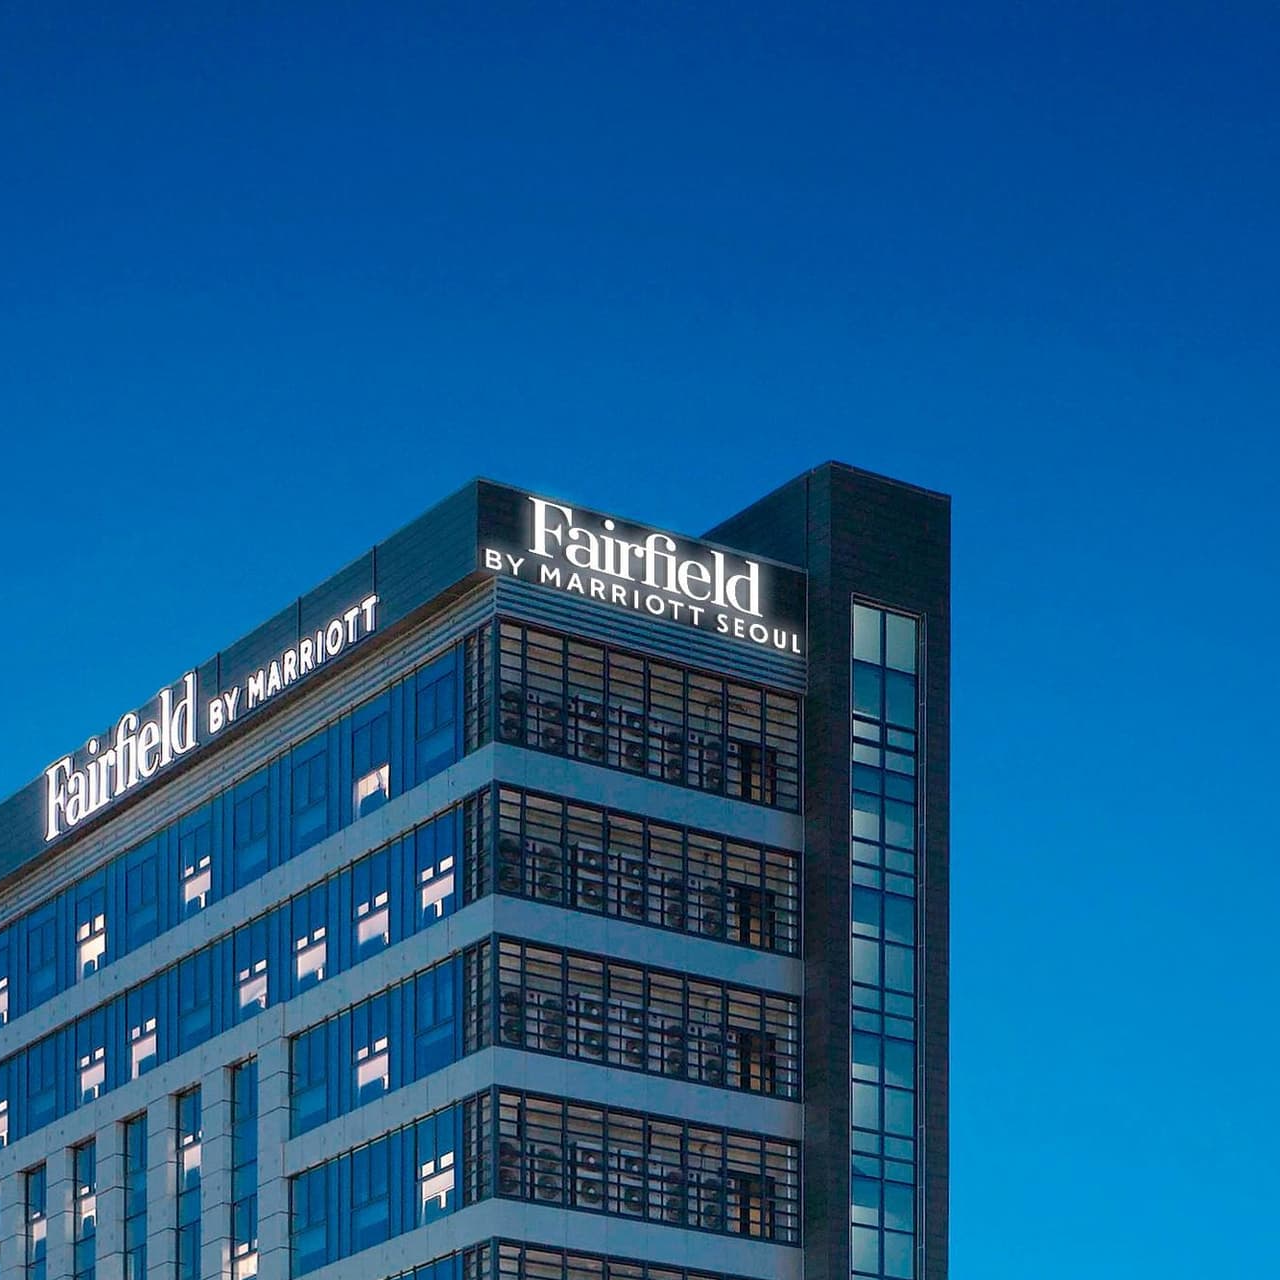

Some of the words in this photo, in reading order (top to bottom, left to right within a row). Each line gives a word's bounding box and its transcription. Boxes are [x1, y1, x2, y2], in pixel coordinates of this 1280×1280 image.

[485, 548, 525, 575] BY
[541, 564, 705, 626] MARRIOTT
[717, 613, 801, 654] SEOUL
[528, 496, 763, 618] Fairfield
[45, 672, 200, 843] Fairfield
[209, 687, 241, 734] BY
[248, 595, 379, 709] MARRIOTT
